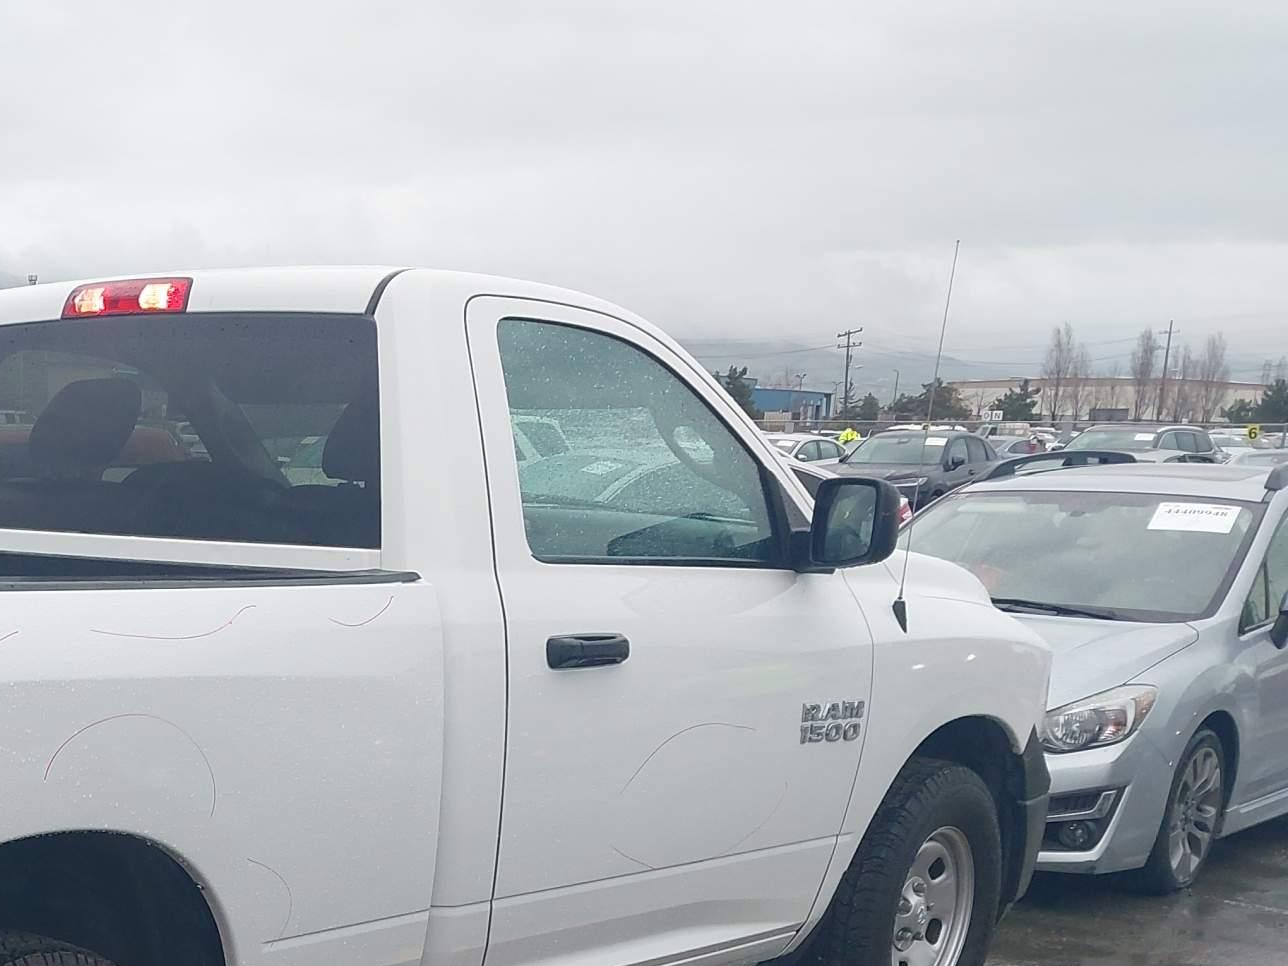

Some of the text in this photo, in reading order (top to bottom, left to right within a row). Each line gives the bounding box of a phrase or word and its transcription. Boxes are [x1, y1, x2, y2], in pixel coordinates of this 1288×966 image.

[1249, 427, 1257, 439] 6
[801, 700, 865, 723] RAM
[800, 721, 861, 745] 1500
